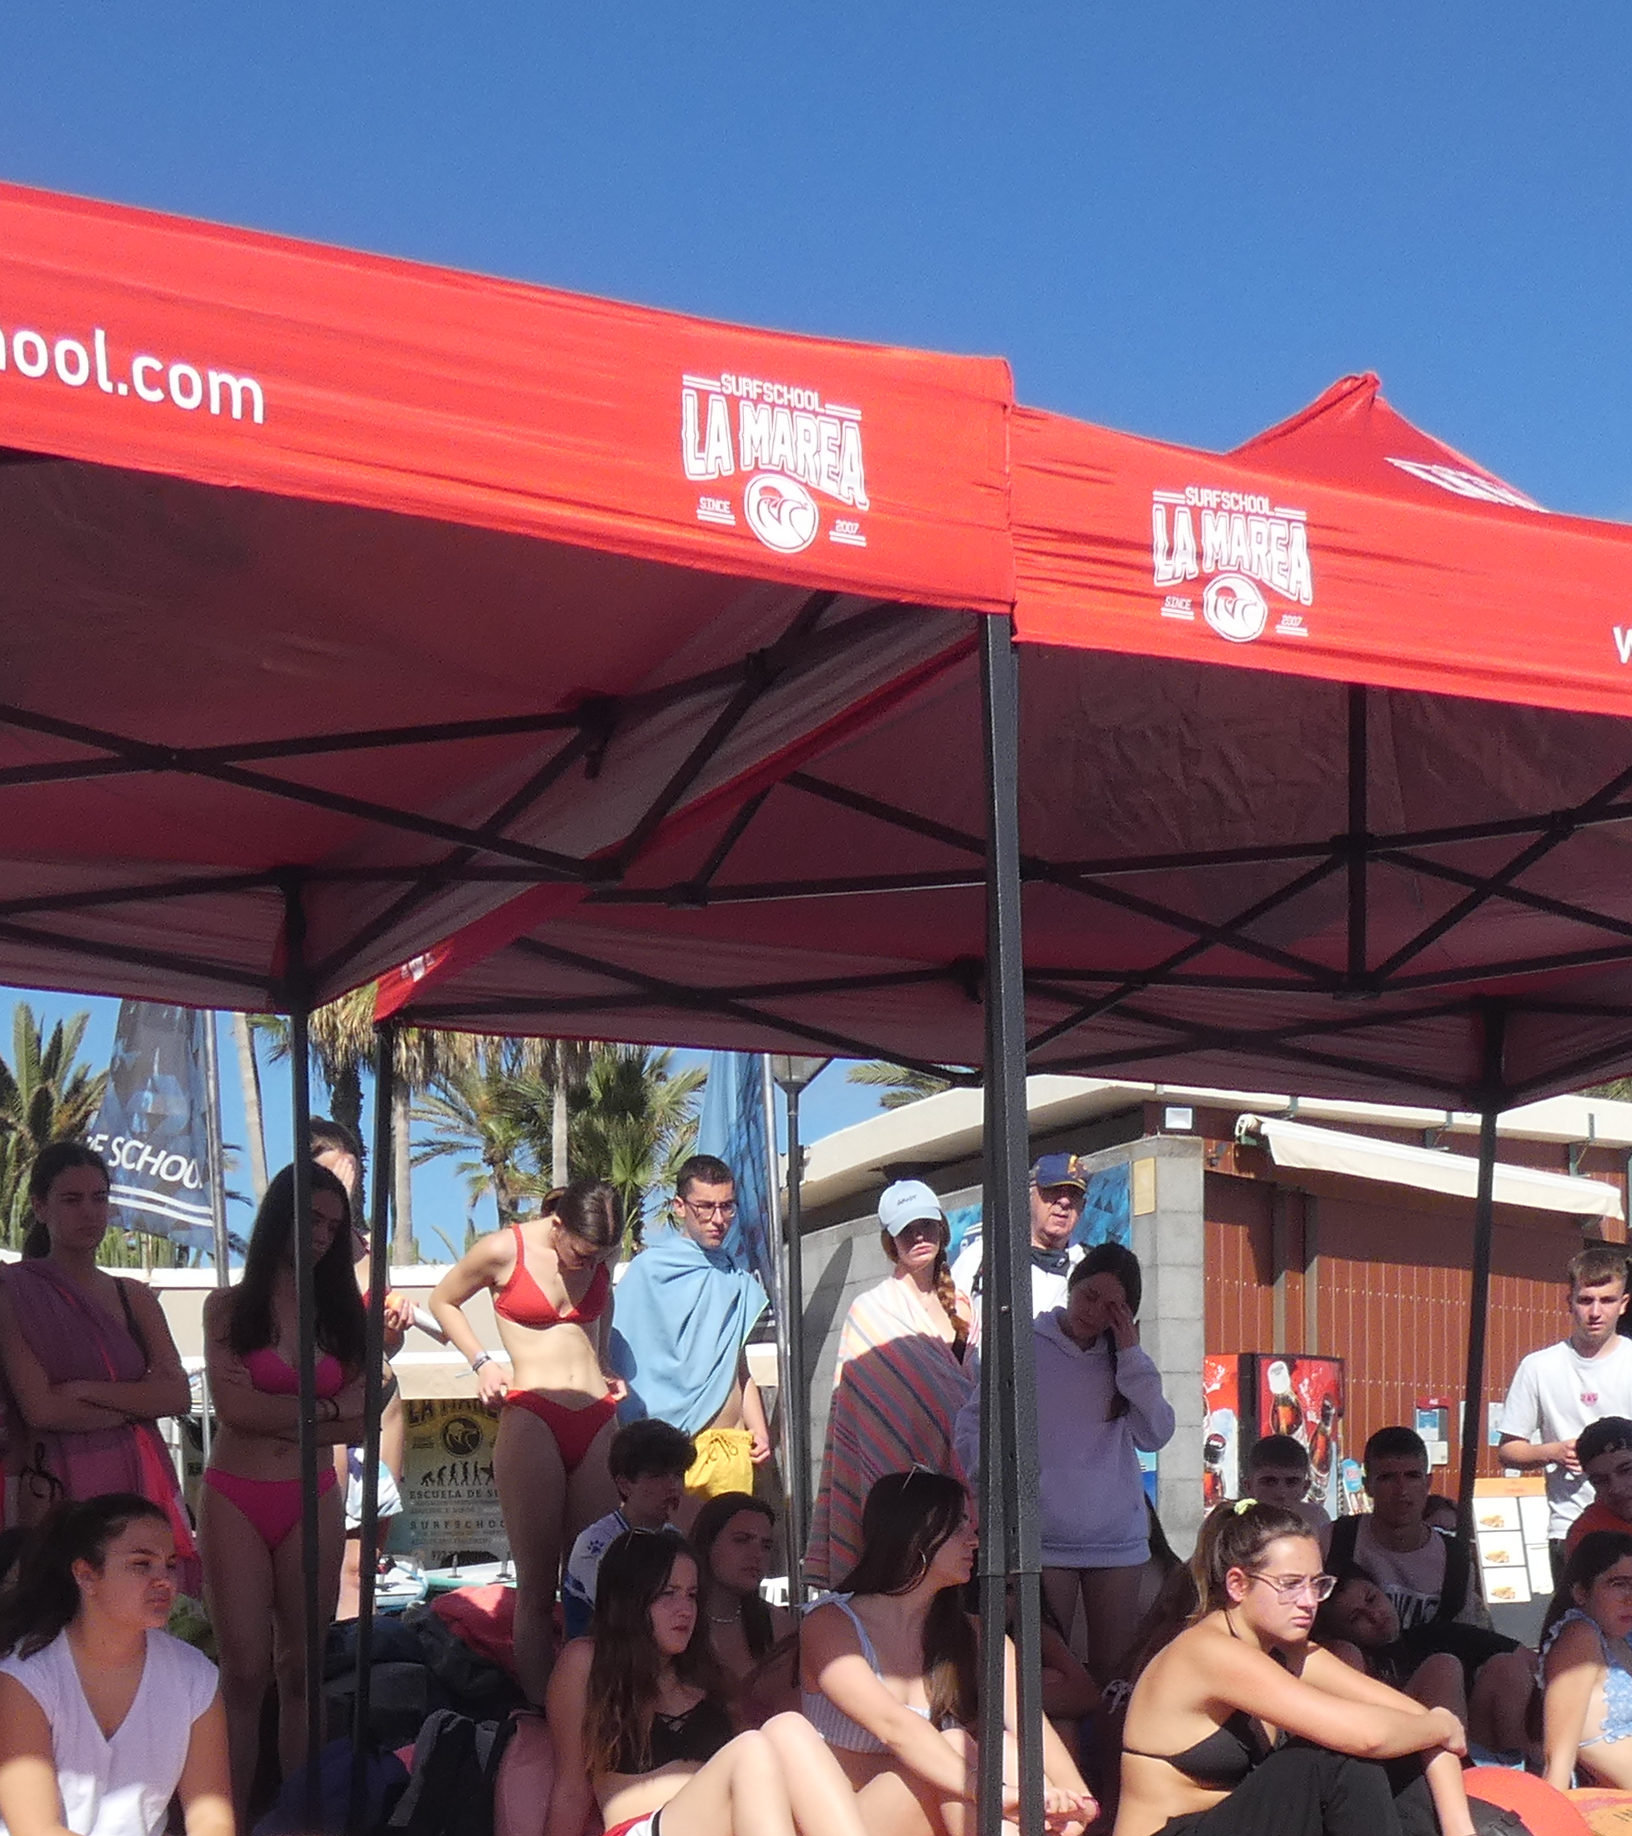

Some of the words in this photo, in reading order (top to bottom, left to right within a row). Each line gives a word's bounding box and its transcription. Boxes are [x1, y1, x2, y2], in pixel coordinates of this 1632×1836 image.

[721, 373, 825, 413] SURFSCHOOL
[682, 388, 735, 481] LA
[739, 400, 870, 512] MAREA
[699, 497, 731, 514] SINCE
[1185, 486, 1275, 516] SURFSCHOOL
[835, 519, 860, 534] 2007
[1153, 503, 1199, 588] LA
[1202, 509, 1313, 607] MAREA
[108, 1135, 203, 1190] SCHOO
[409, 1489, 463, 1500] ESCUELA
[468, 1489, 484, 1499] DE
